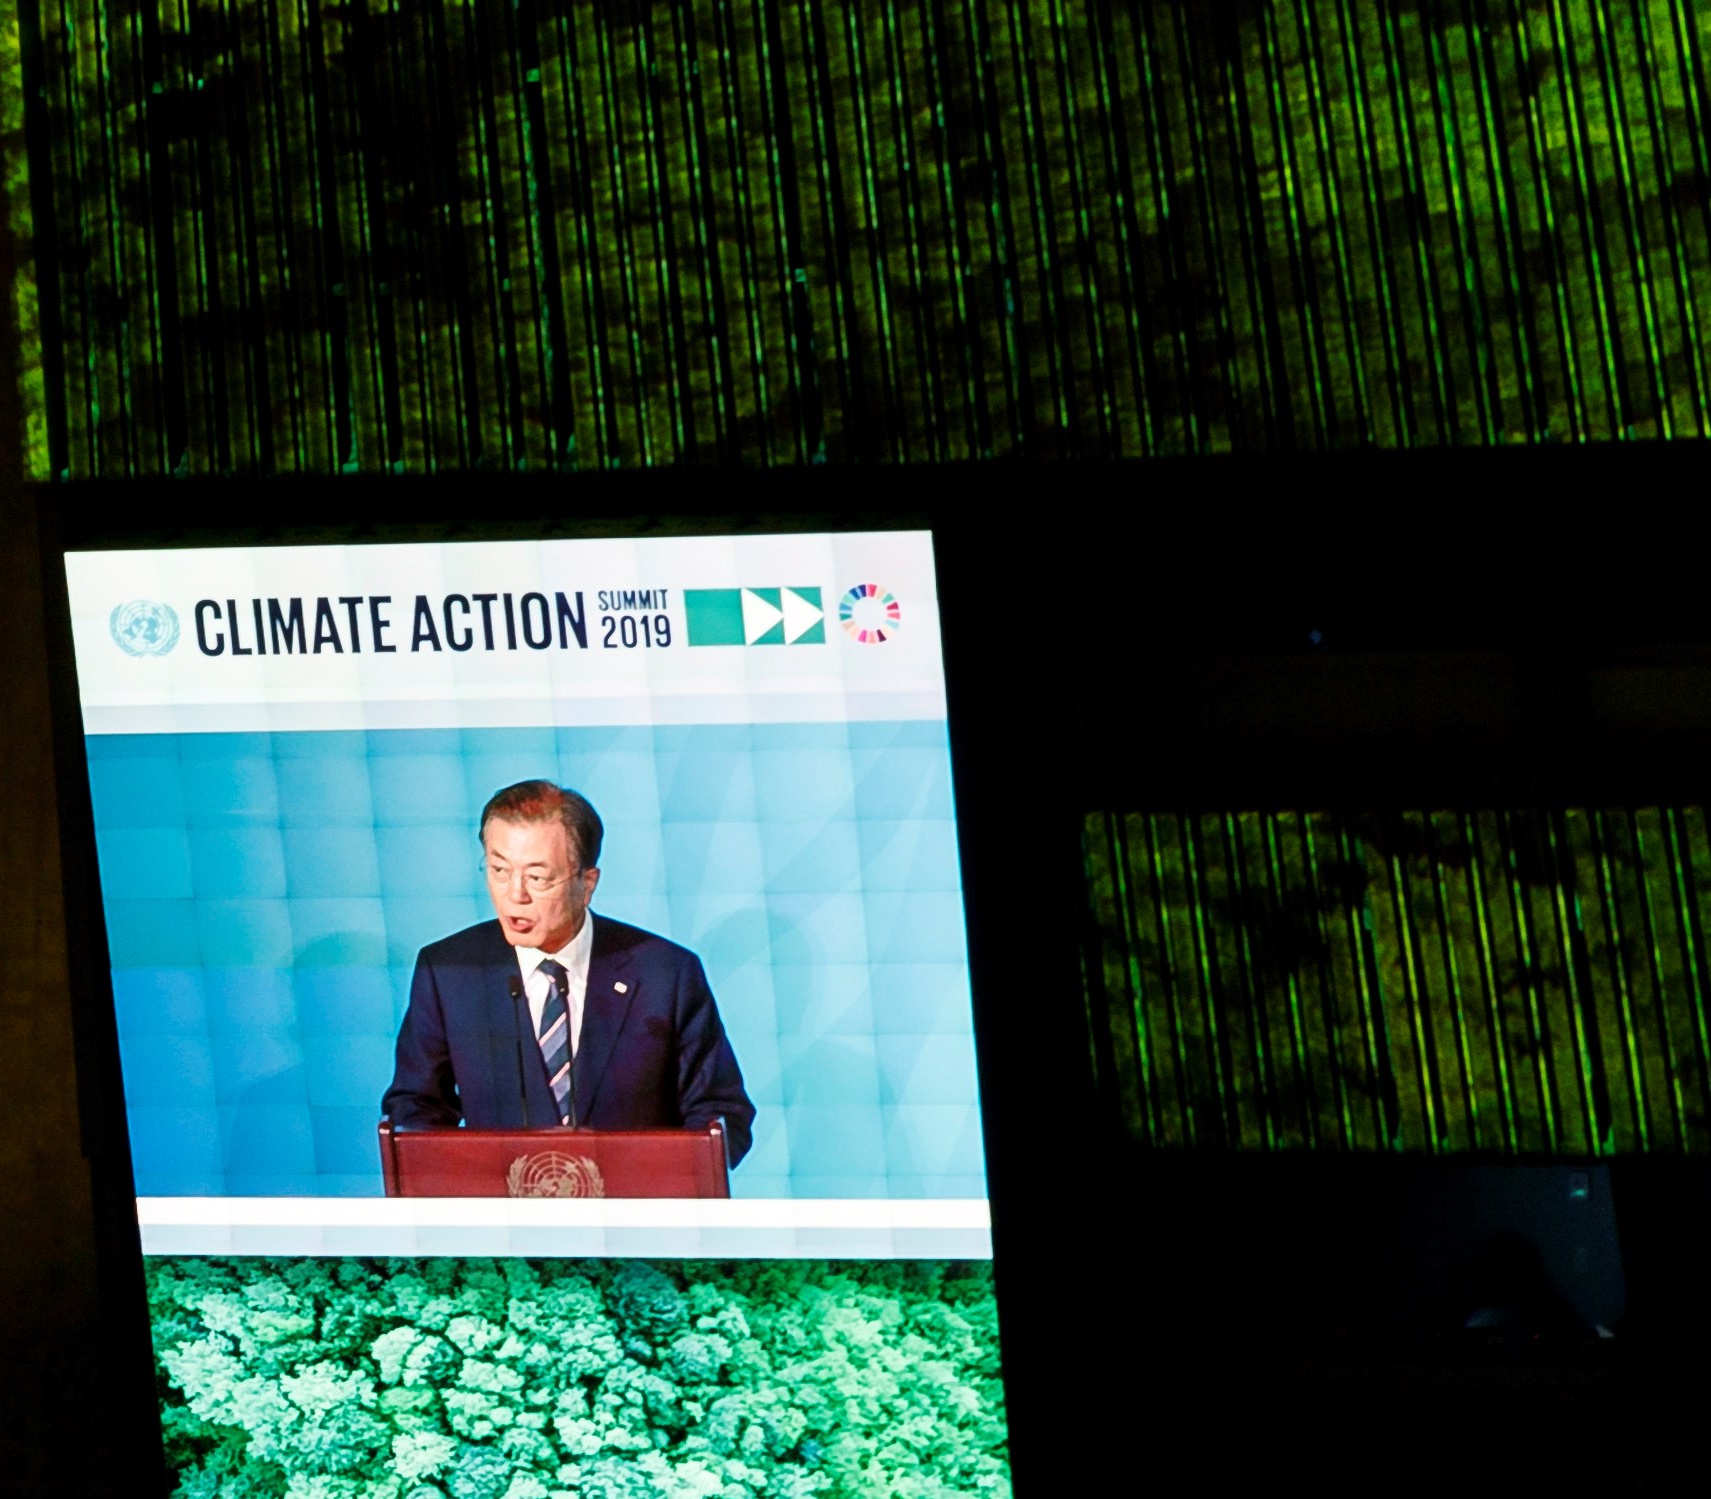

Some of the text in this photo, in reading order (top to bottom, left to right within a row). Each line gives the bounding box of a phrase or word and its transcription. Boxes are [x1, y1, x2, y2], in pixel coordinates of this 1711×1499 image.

[597, 588, 668, 612] SUMMIT
[194, 591, 589, 657] CLIMATE ACTION
[600, 614, 672, 649] 2019
